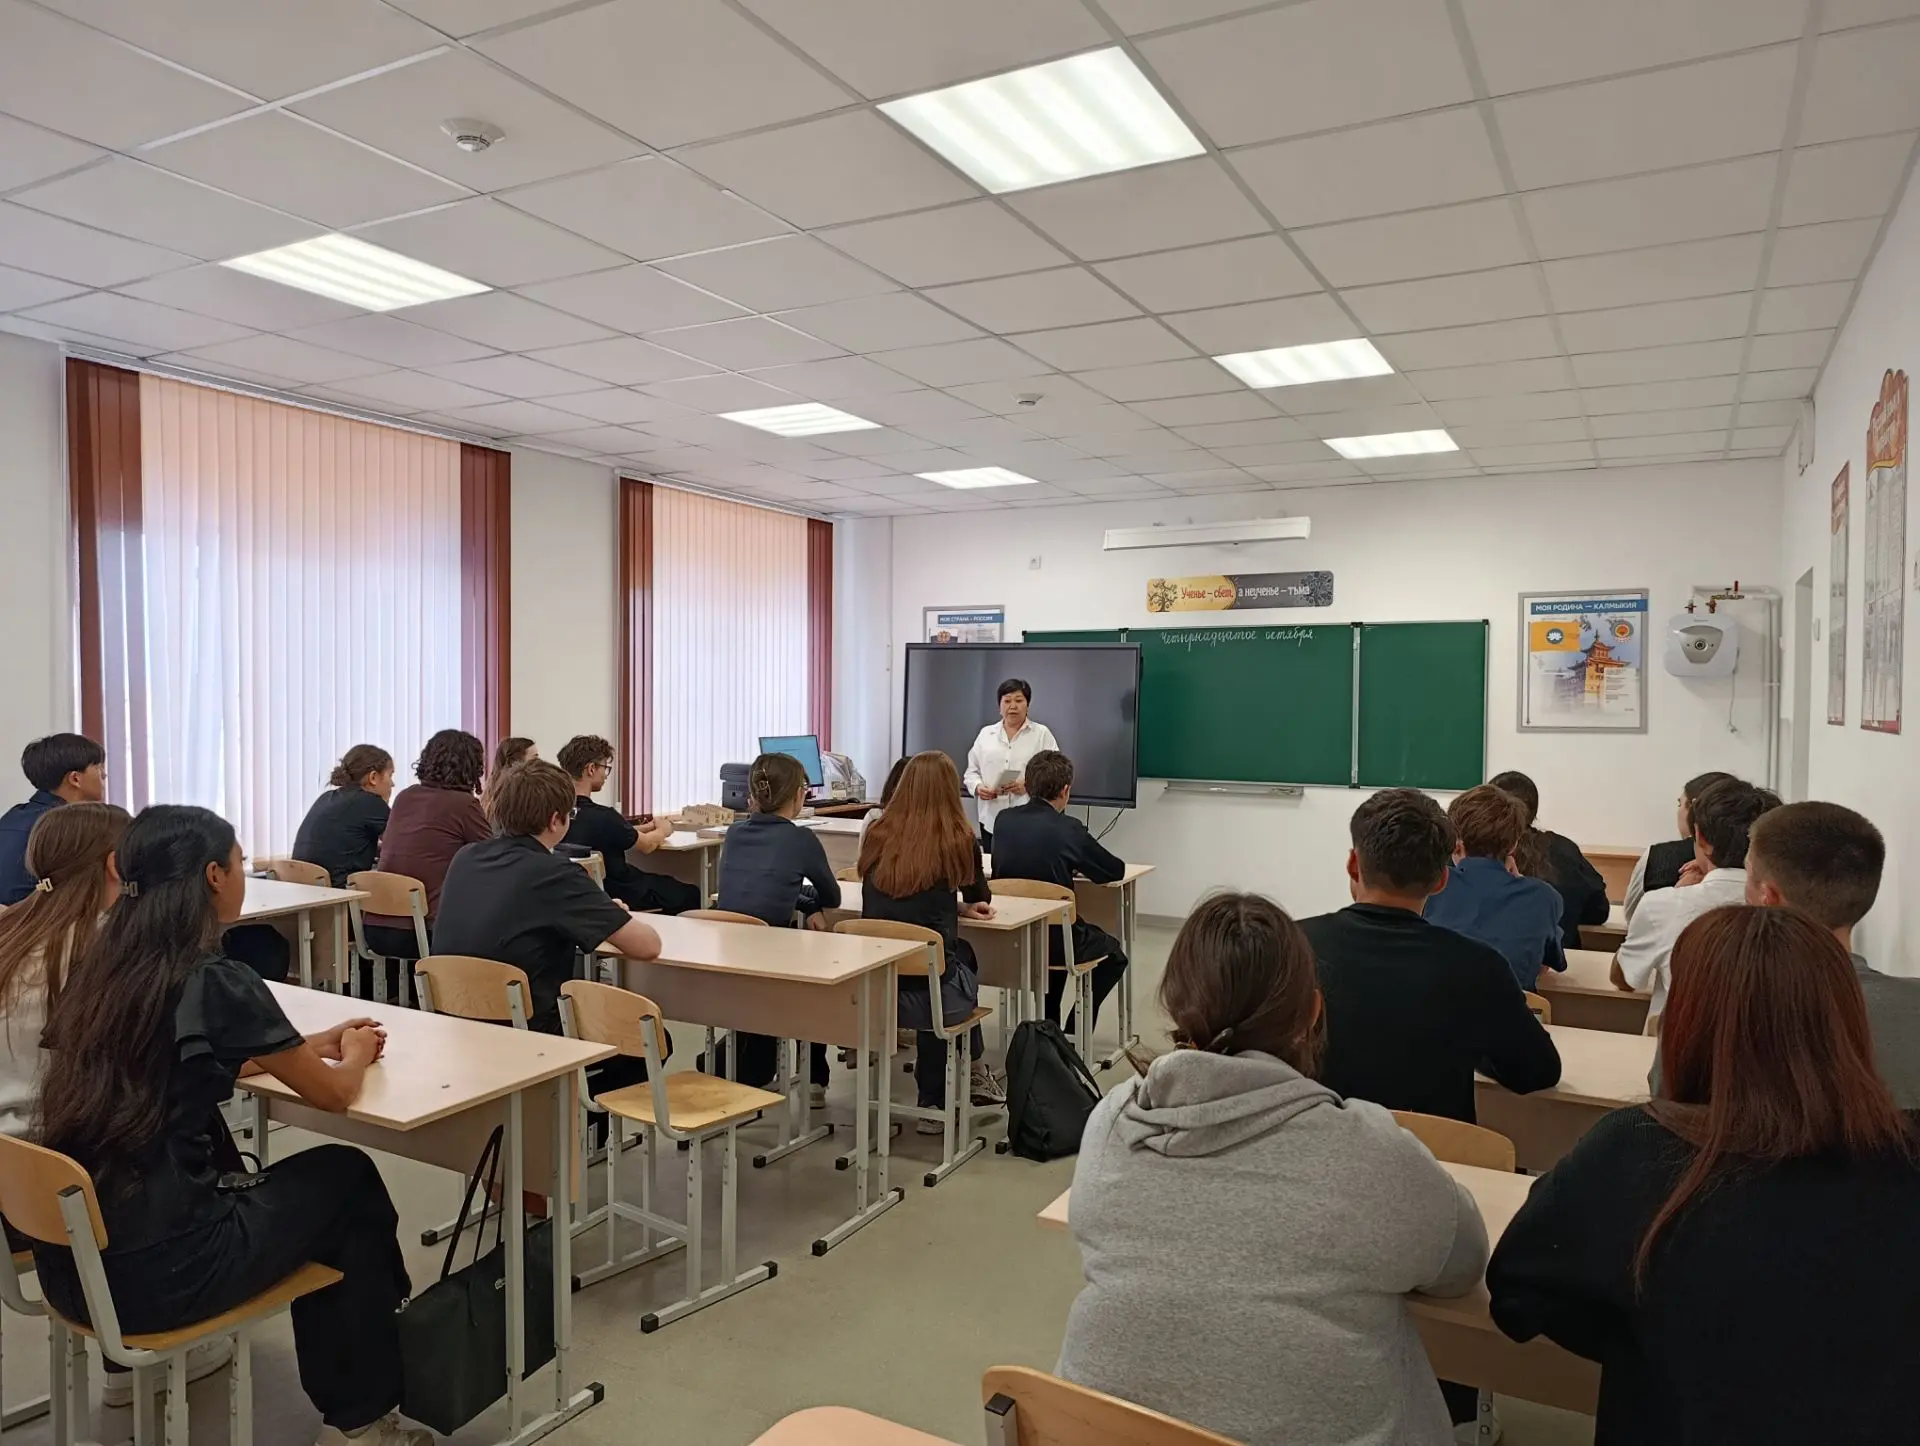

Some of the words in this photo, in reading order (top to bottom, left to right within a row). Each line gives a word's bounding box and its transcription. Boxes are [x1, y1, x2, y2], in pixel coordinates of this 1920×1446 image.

[1181, 587, 1206, 599] Ученье
[1238, 588, 1243, 597] а
[1244, 586, 1279, 600] неученье
[1287, 586, 1310, 596] тьма
[1535, 604, 1552, 612] МОЯ
[1553, 603, 1583, 611] РОДИНА
[1593, 601, 1637, 610] КАЛМЫКИЯ
[1160, 630, 1257, 652] Четырнадцатое
